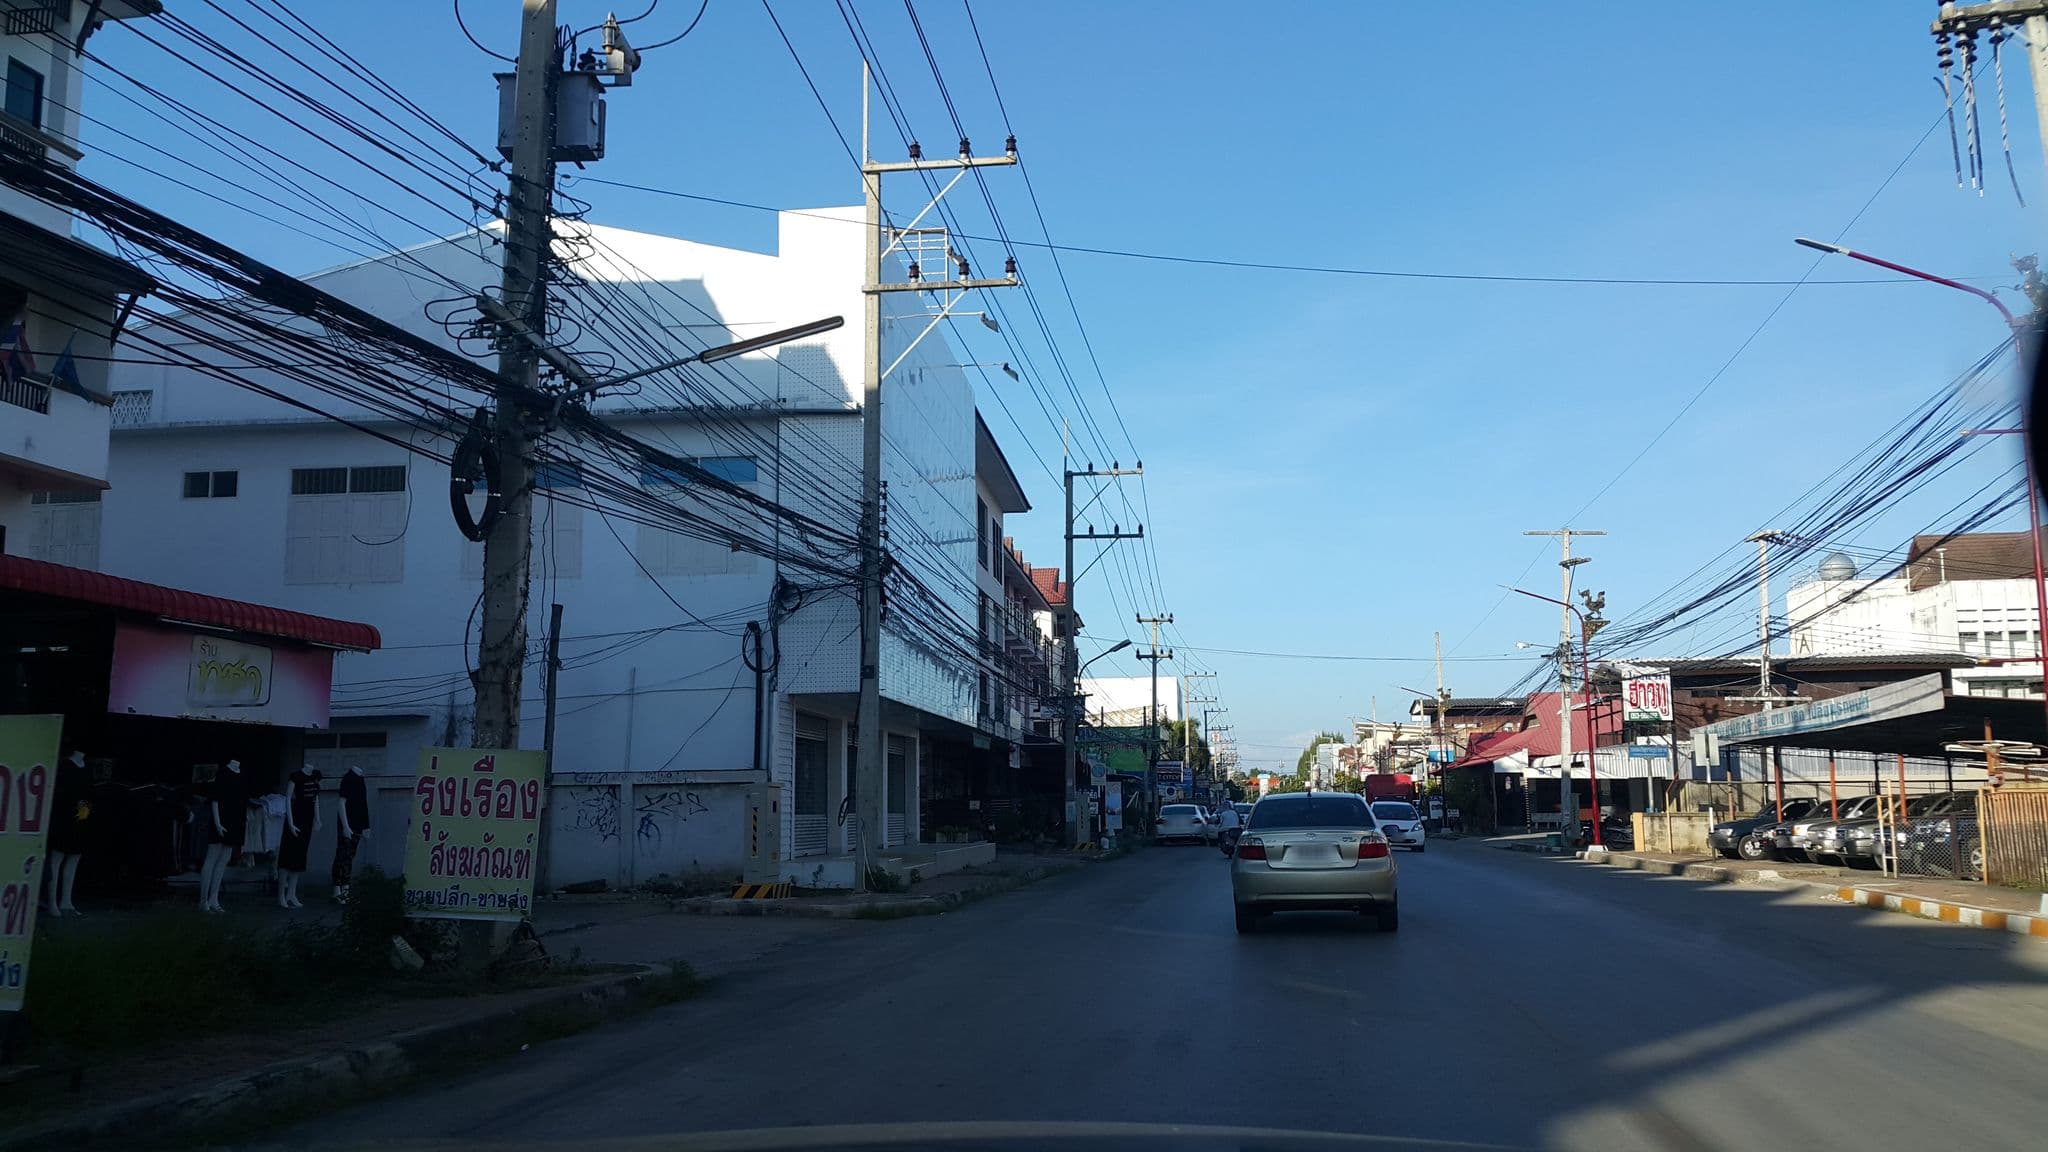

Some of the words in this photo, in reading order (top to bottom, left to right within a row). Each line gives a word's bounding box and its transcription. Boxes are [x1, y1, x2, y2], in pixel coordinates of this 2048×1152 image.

[415, 755, 540, 842] รุ่งเรือง
[405, 884, 529, 910] ขายปลีก-ขายส่ง
